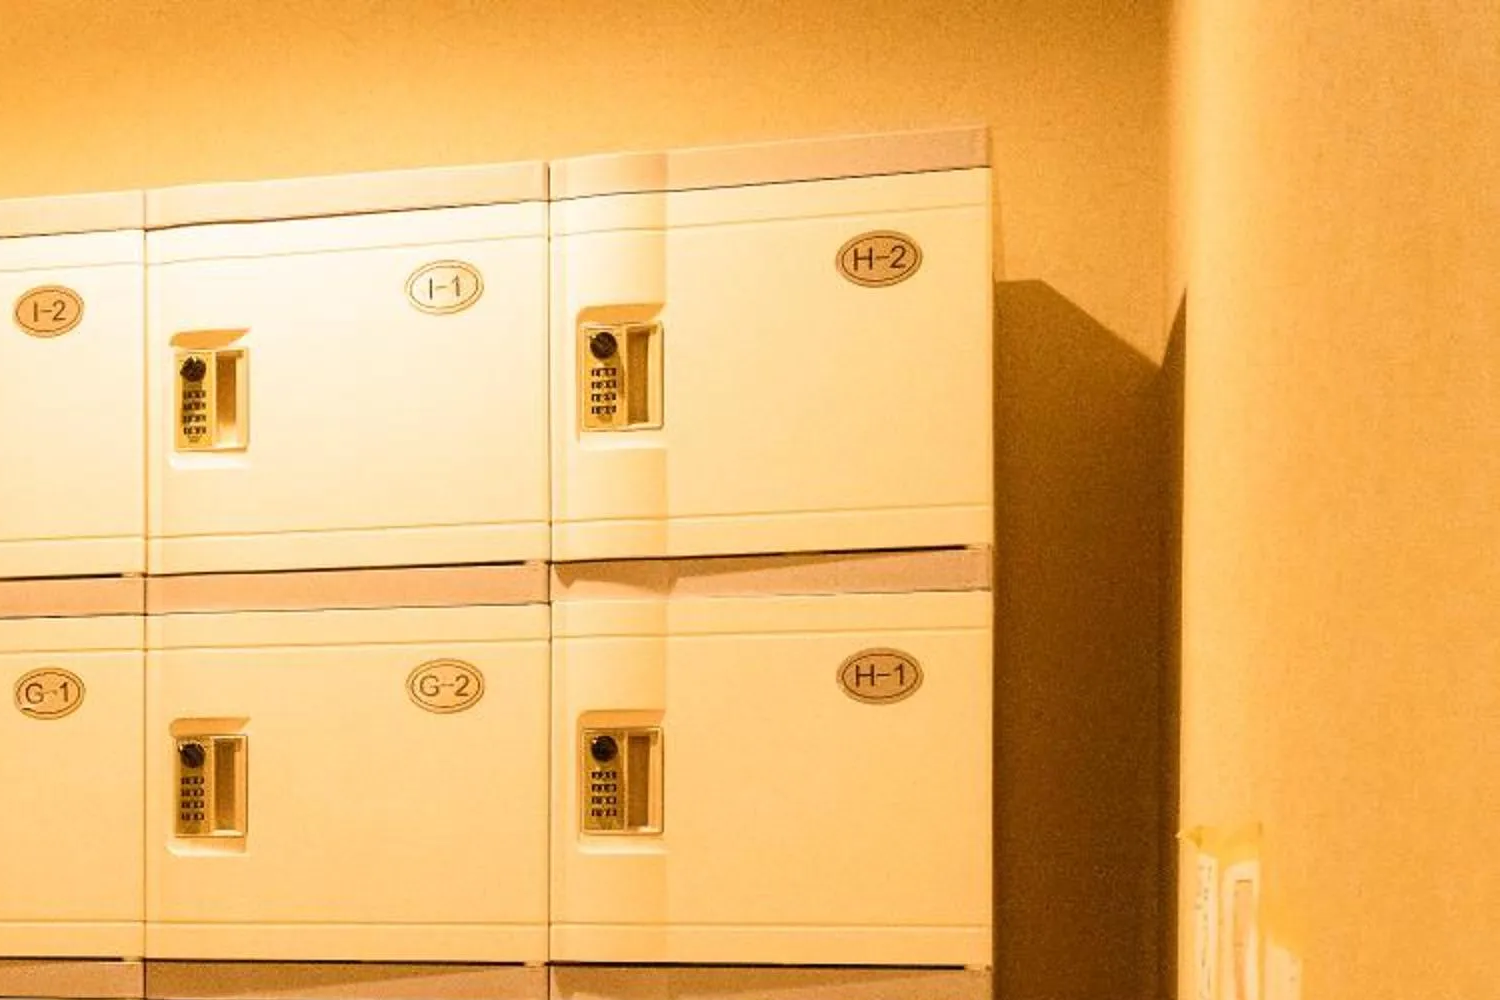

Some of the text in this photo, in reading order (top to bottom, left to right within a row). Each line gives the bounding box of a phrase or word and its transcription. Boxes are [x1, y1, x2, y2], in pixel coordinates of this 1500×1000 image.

[853, 245, 906, 271] H-2
[428, 275, 461, 300] I-1
[33, 300, 67, 323] I-2
[419, 674, 470, 698] G-2
[854, 663, 906, 688] H-1
[25, 682, 69, 704] G-1
